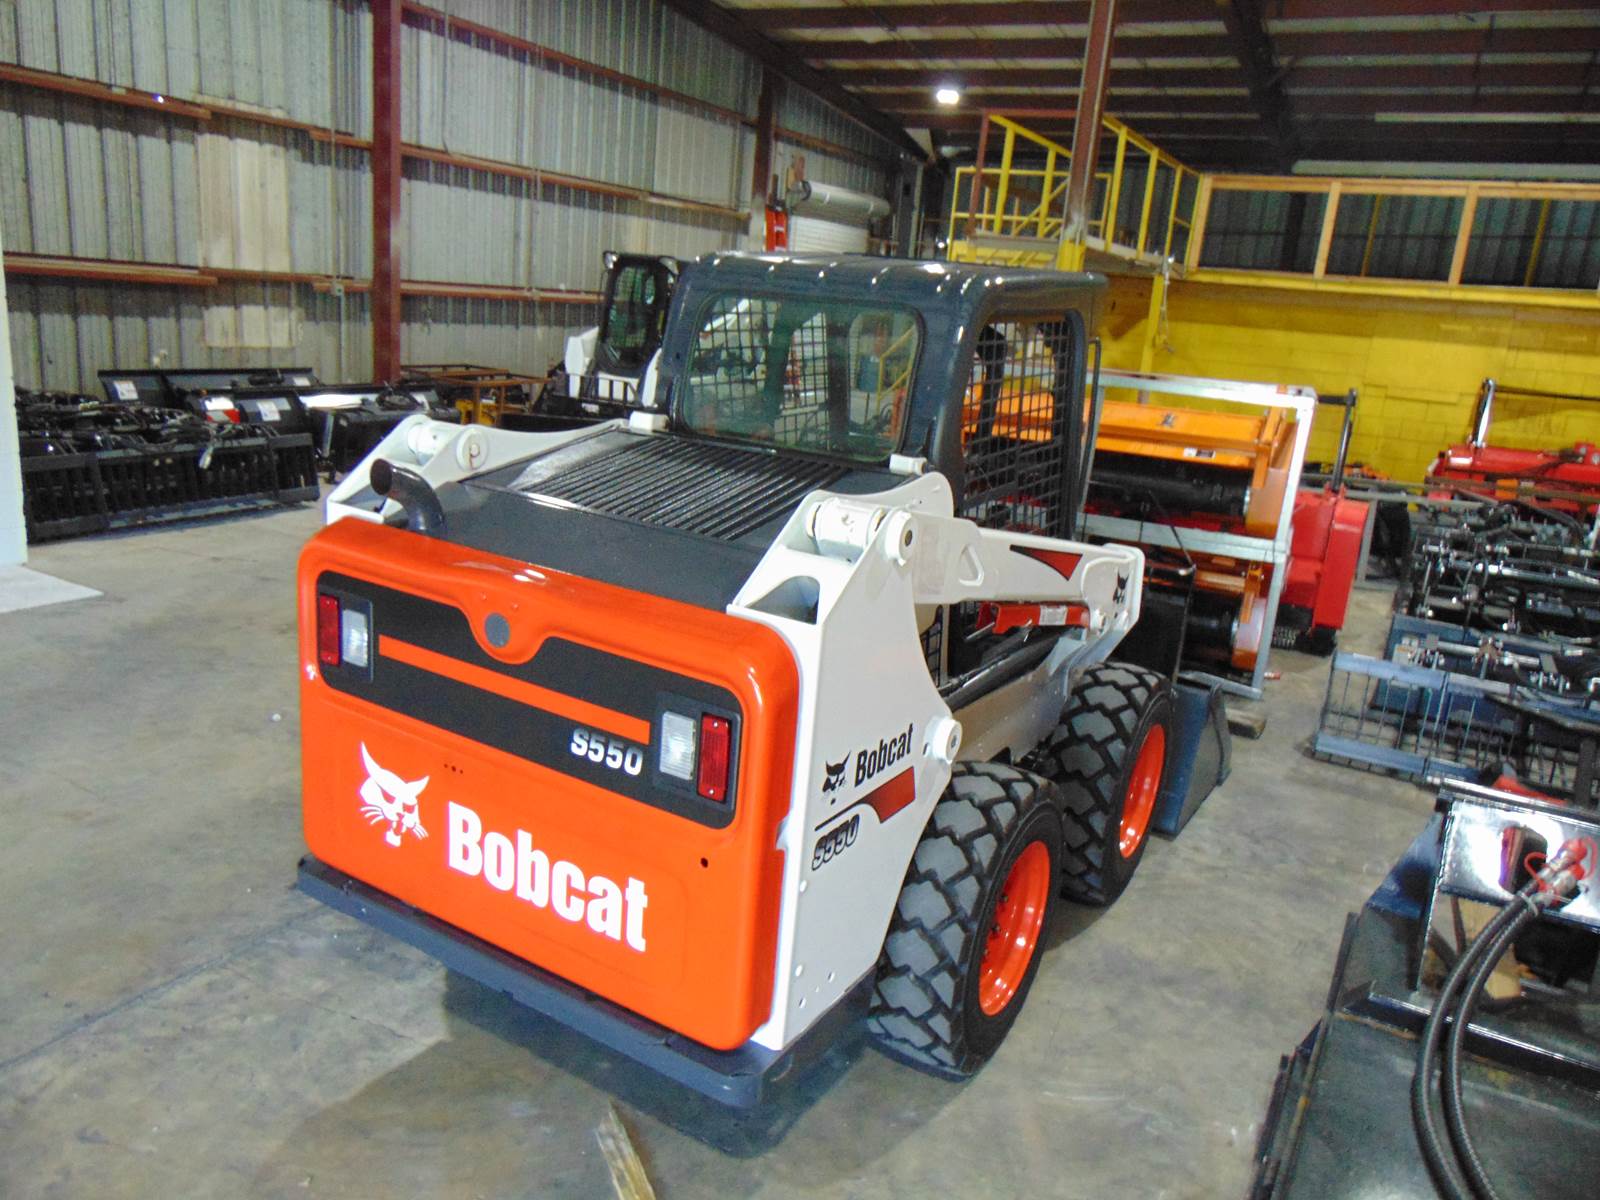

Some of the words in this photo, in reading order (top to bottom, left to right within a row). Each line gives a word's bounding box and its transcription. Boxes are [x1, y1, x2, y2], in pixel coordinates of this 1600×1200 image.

[569, 728, 643, 776] S550
[854, 723, 914, 787] Bobcat
[812, 814, 860, 871] S550
[448, 801, 648, 952] Bobcat
